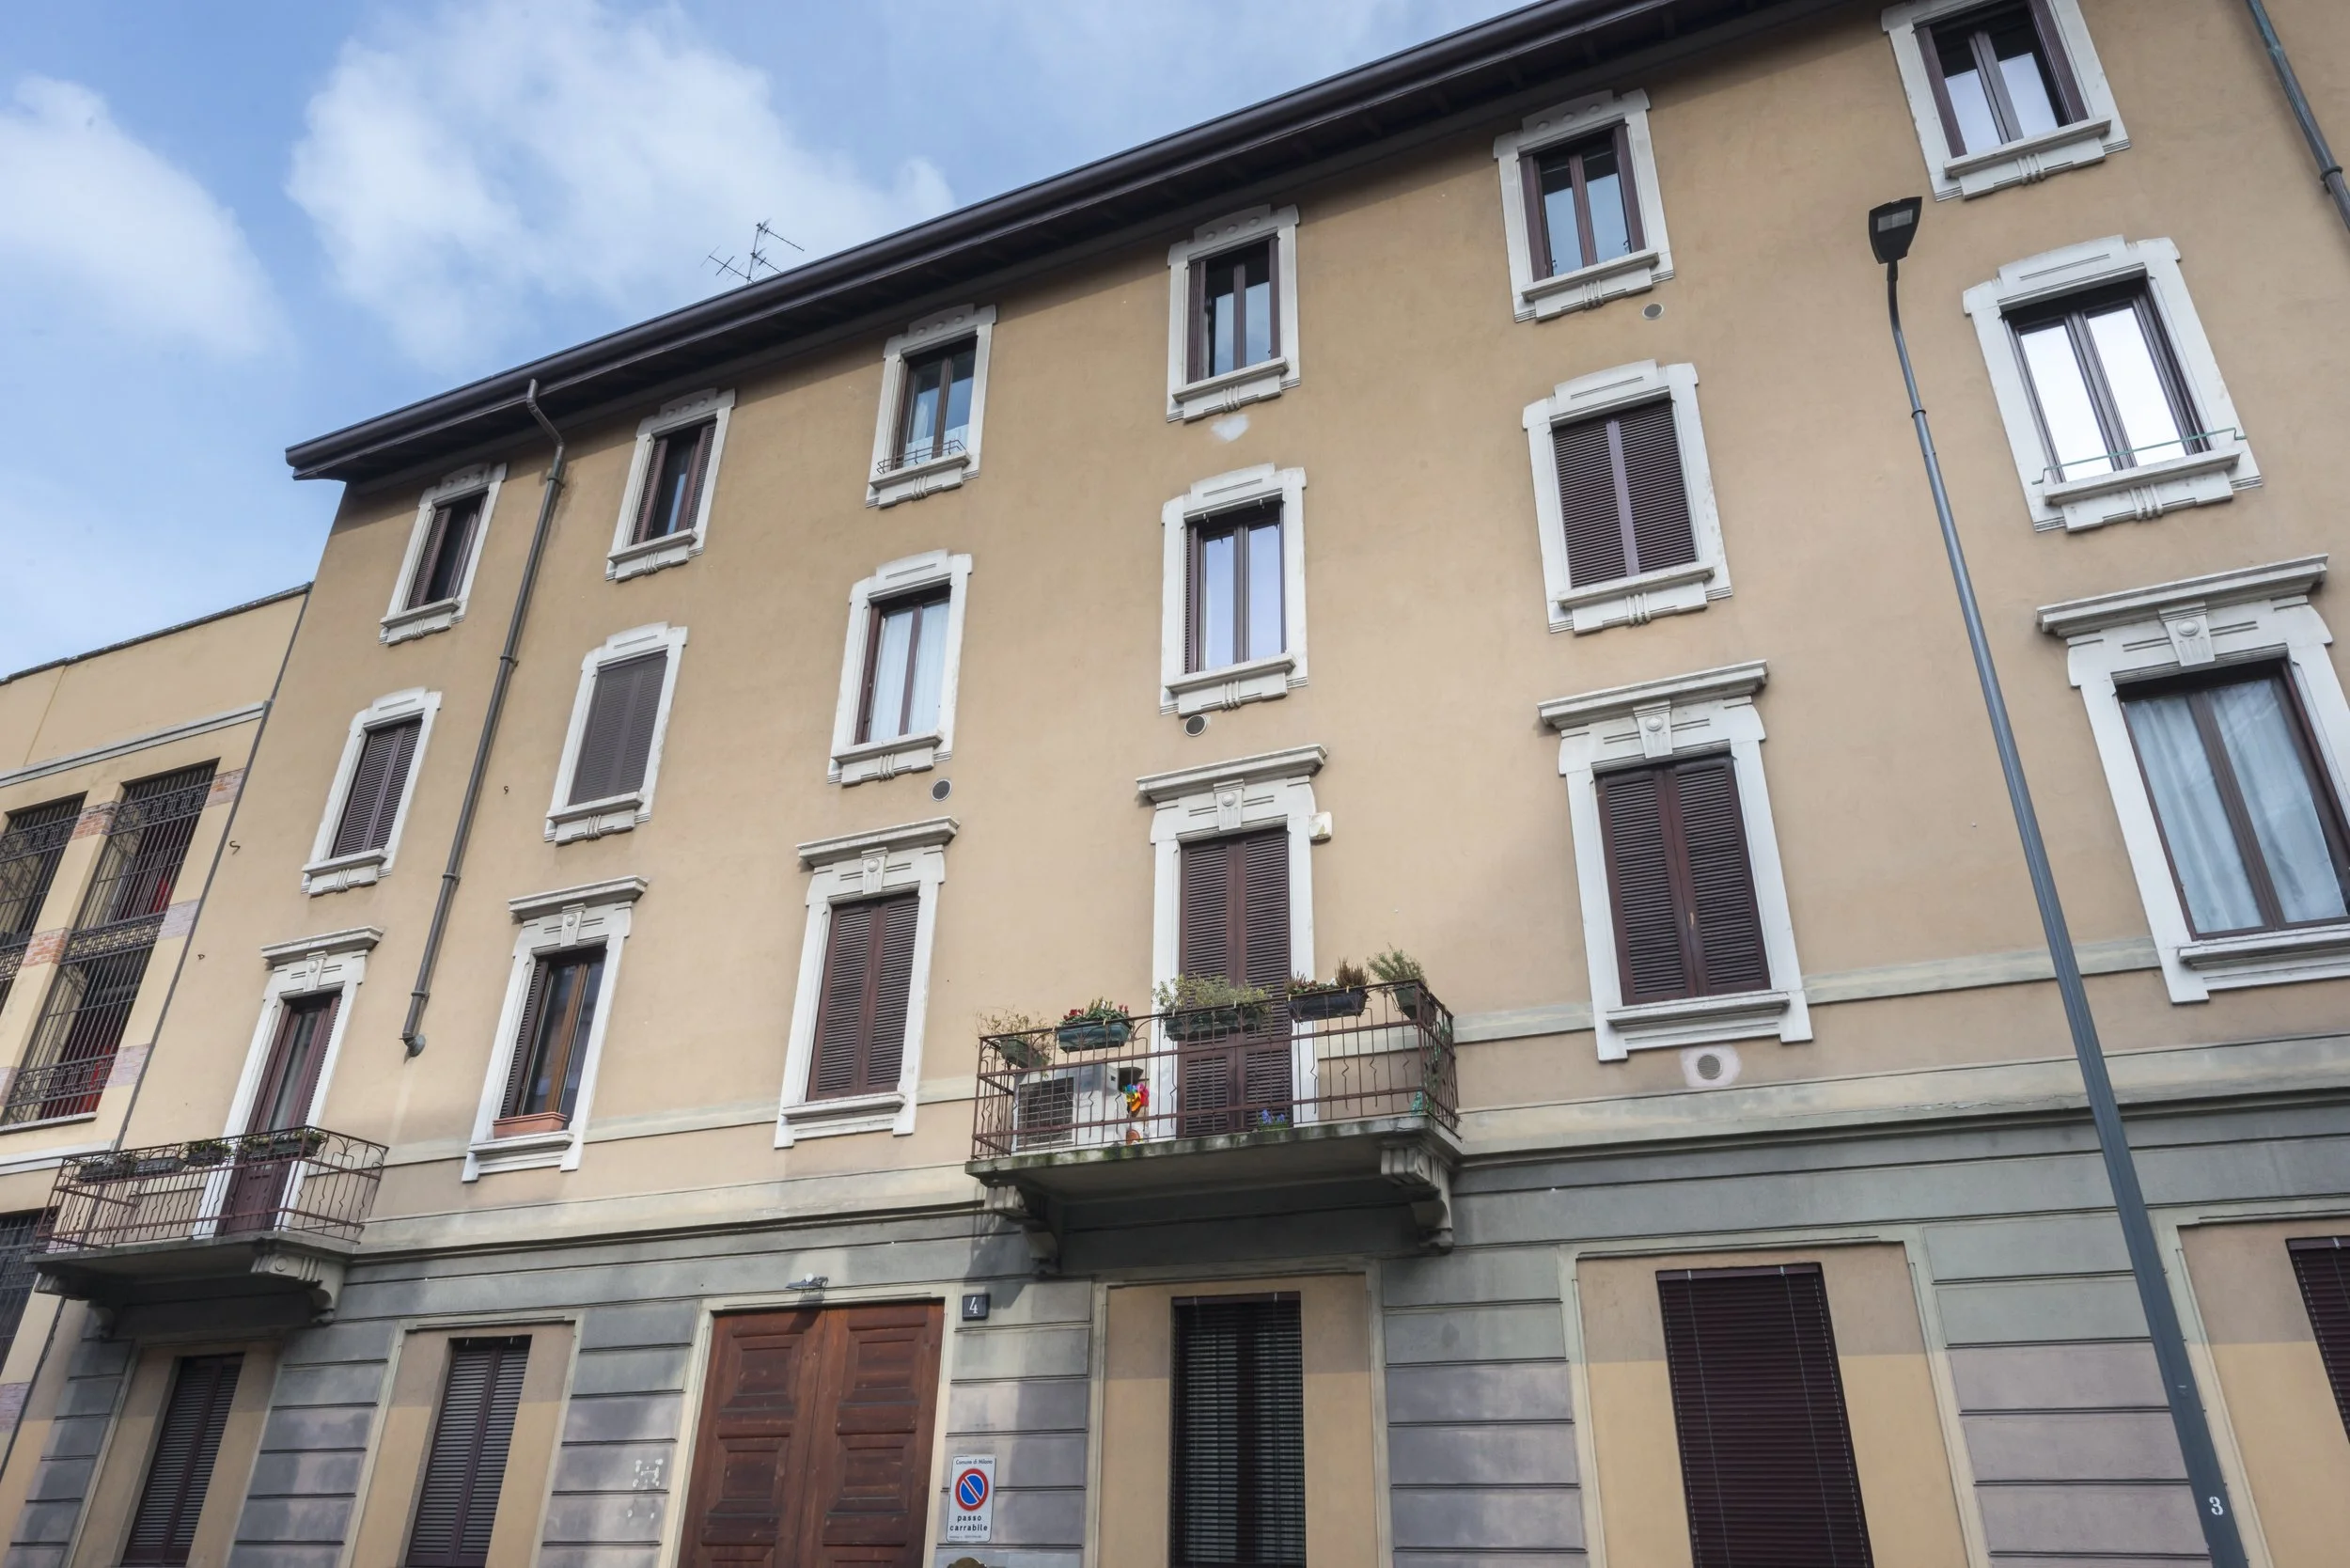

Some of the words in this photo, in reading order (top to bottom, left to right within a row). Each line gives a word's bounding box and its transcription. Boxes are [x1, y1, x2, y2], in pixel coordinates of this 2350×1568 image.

[969, 1296, 979, 1314] 4
[2209, 1496, 2224, 1515] 3
[957, 1514, 982, 1523] passo
[949, 1523, 988, 1531] carrabile
